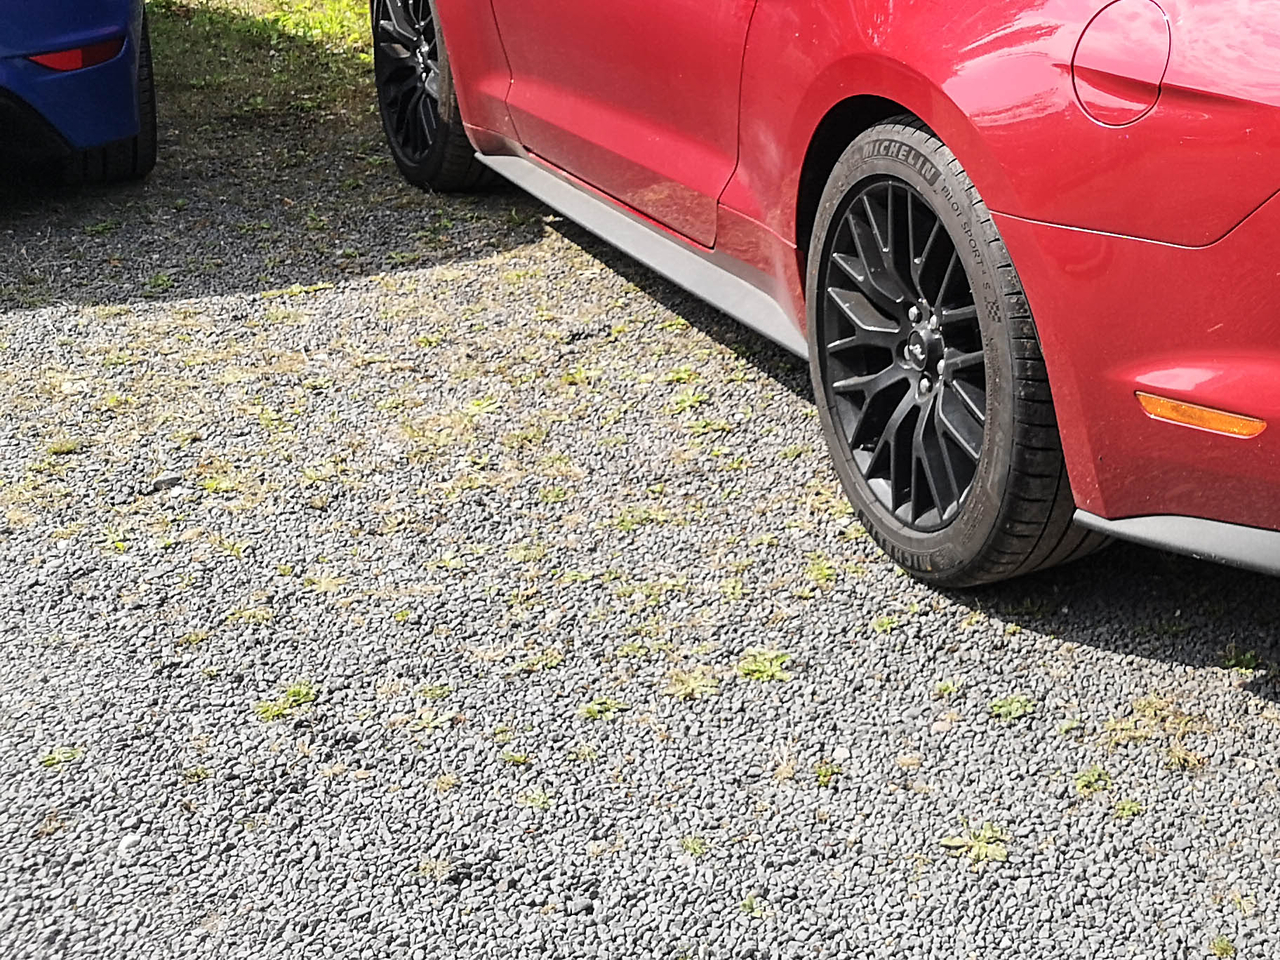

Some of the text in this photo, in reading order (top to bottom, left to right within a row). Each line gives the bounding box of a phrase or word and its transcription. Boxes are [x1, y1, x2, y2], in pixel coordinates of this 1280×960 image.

[862, 141, 936, 180] MICHELIN
[940, 184, 963, 218] PILOT
[960, 221, 984, 266] SPORT
